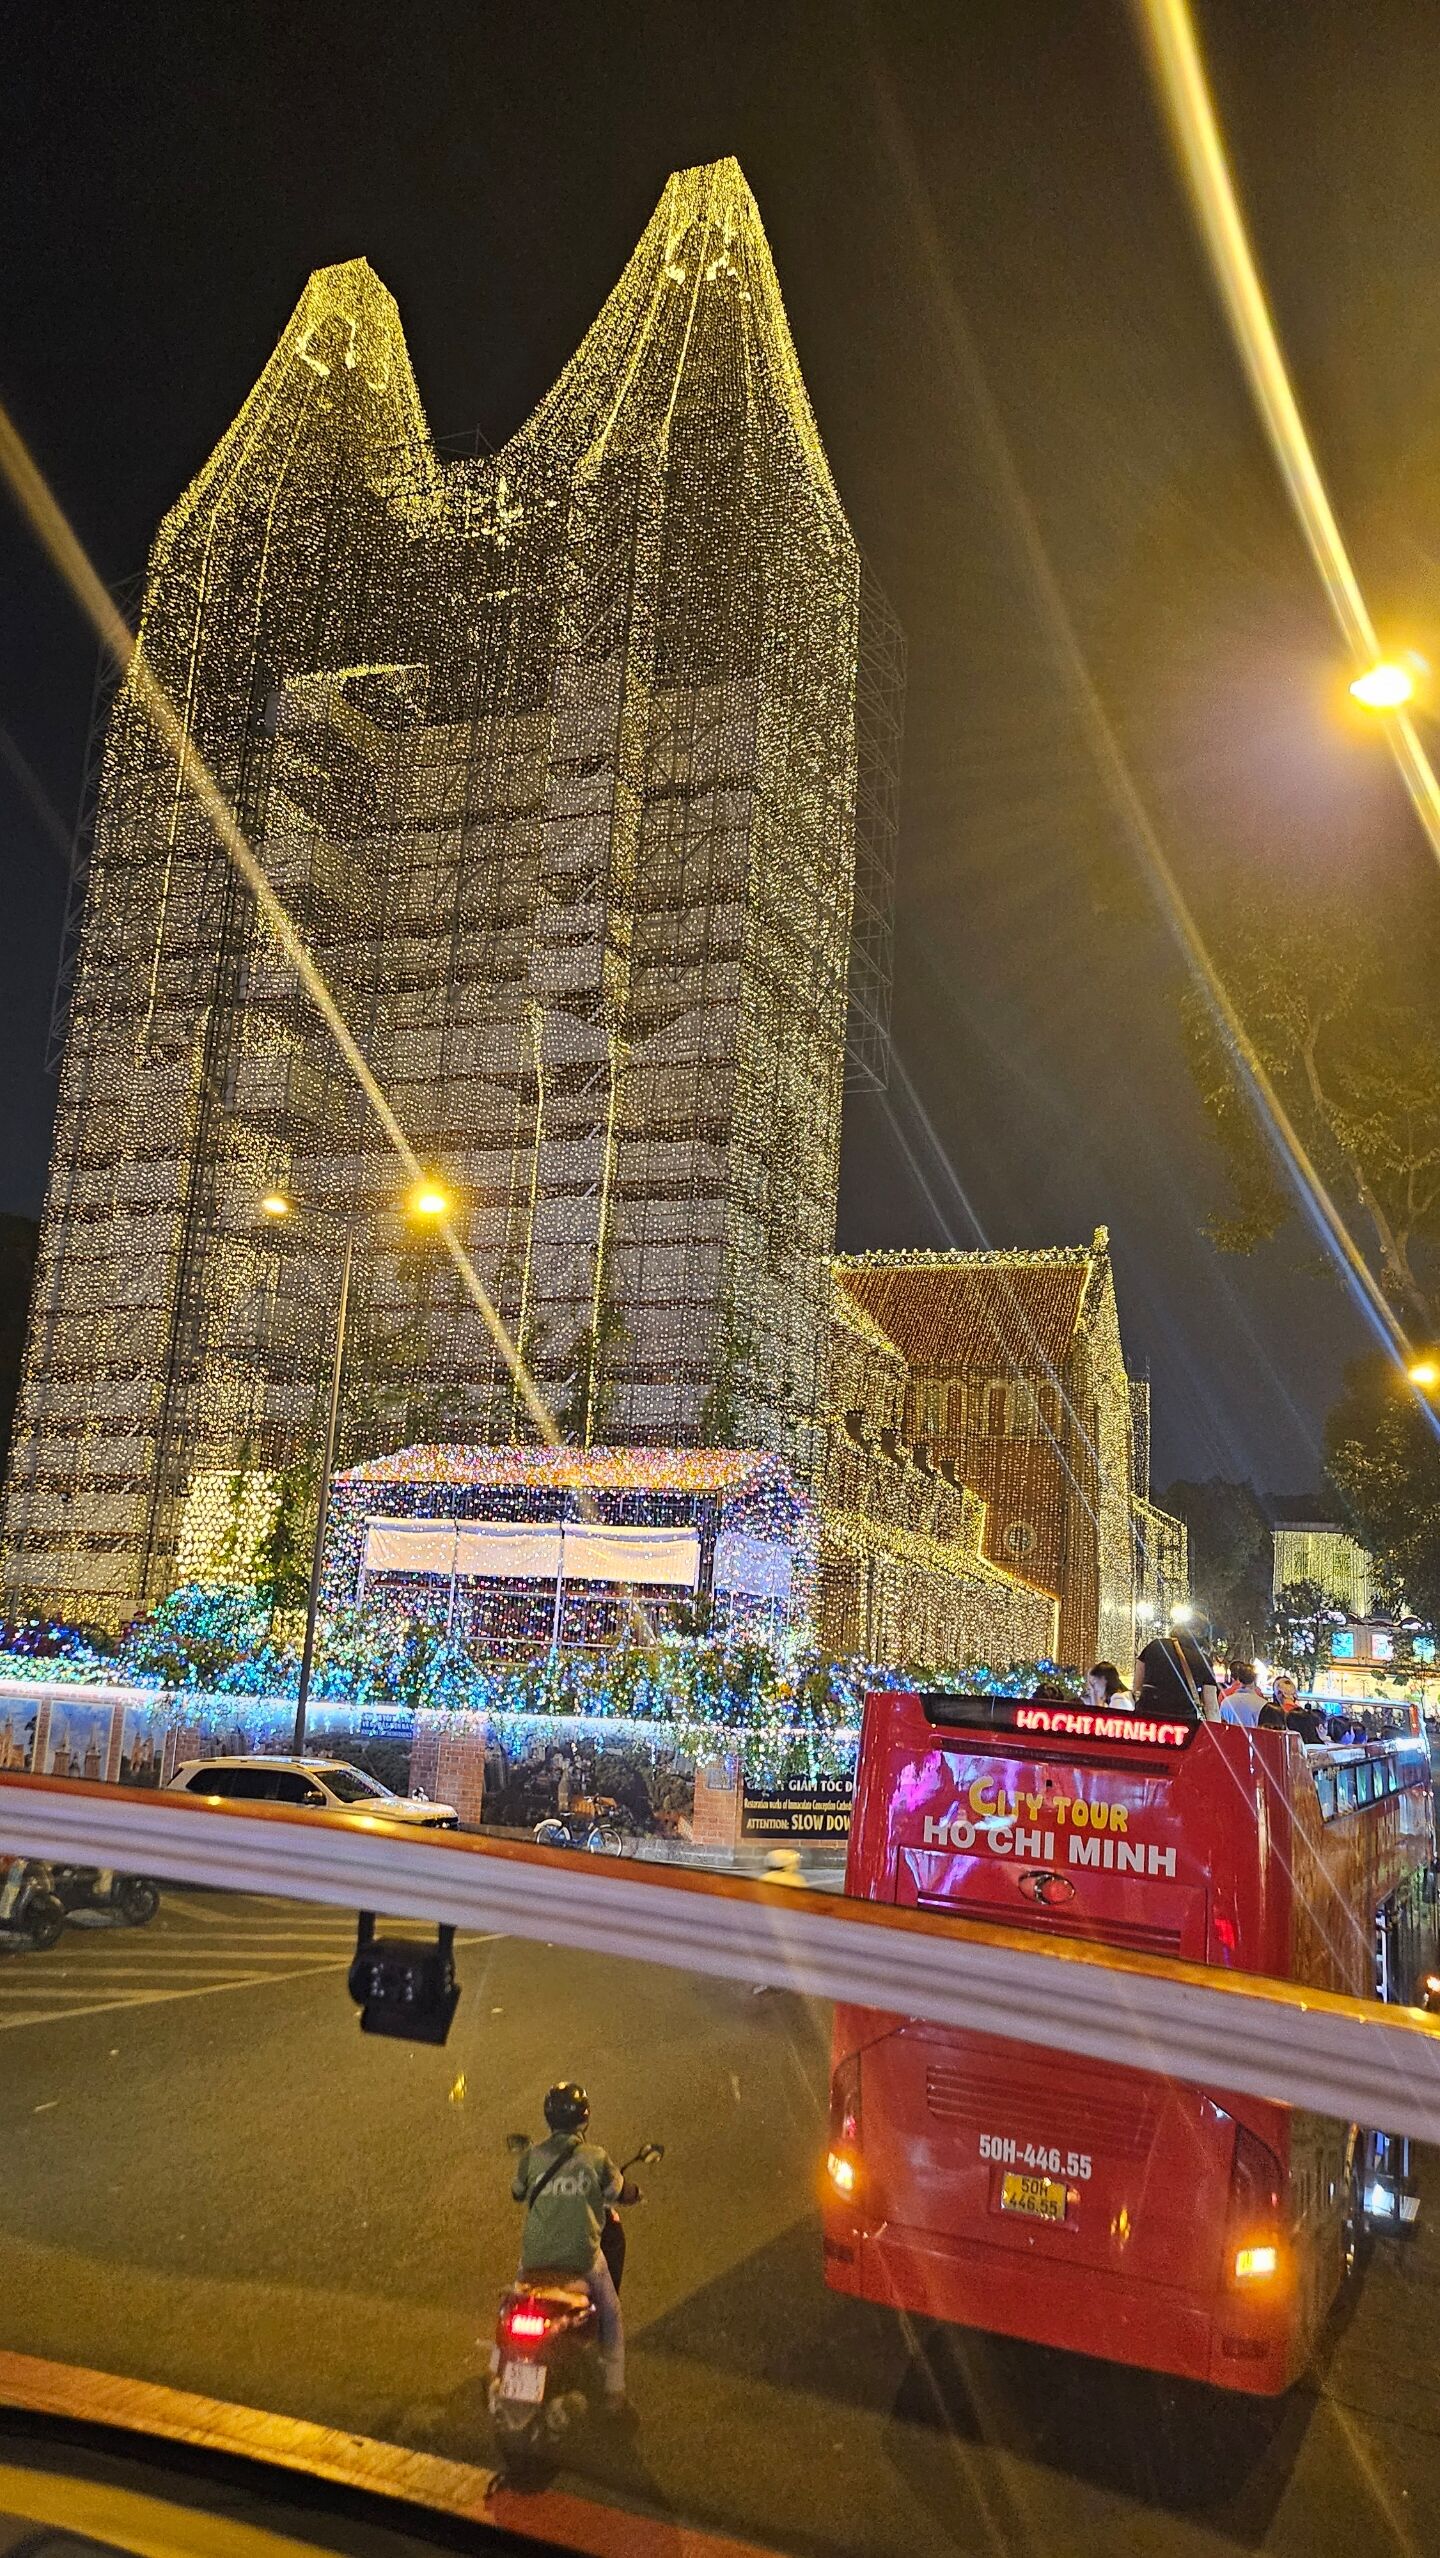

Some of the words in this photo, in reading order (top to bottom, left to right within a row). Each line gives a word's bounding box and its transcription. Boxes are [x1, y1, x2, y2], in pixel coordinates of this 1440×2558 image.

[1016, 1709, 1050, 1731] HO
[1051, 1712, 1094, 1735] CHI
[1094, 1716, 1157, 1743] MINH
[788, 1776, 818, 1792] GIẢM
[820, 1775, 843, 1793] TỐC
[744, 1797, 769, 1809] Restoration
[782, 1798, 788, 1809] of
[788, 1798, 812, 1810] Immaculate
[812, 1799, 836, 1812] Conception
[836, 1799, 853, 1811] Cathed
[968, 1775, 1043, 1822] CITY
[1052, 1796, 1129, 1833] TOUR
[746, 1817, 790, 1830] ATTENTION:
[791, 1814, 823, 1831] SLOW
[826, 1815, 851, 1831] DOW
[923, 1815, 977, 1849] HO
[987, 1826, 1056, 1861] CHI
[1068, 1834, 1177, 1878] MINH
[979, 2133, 1093, 2180] 50H-446.55
[1020, 2177, 1049, 2197] 50H
[1008, 2191, 1059, 2216] 446.55
